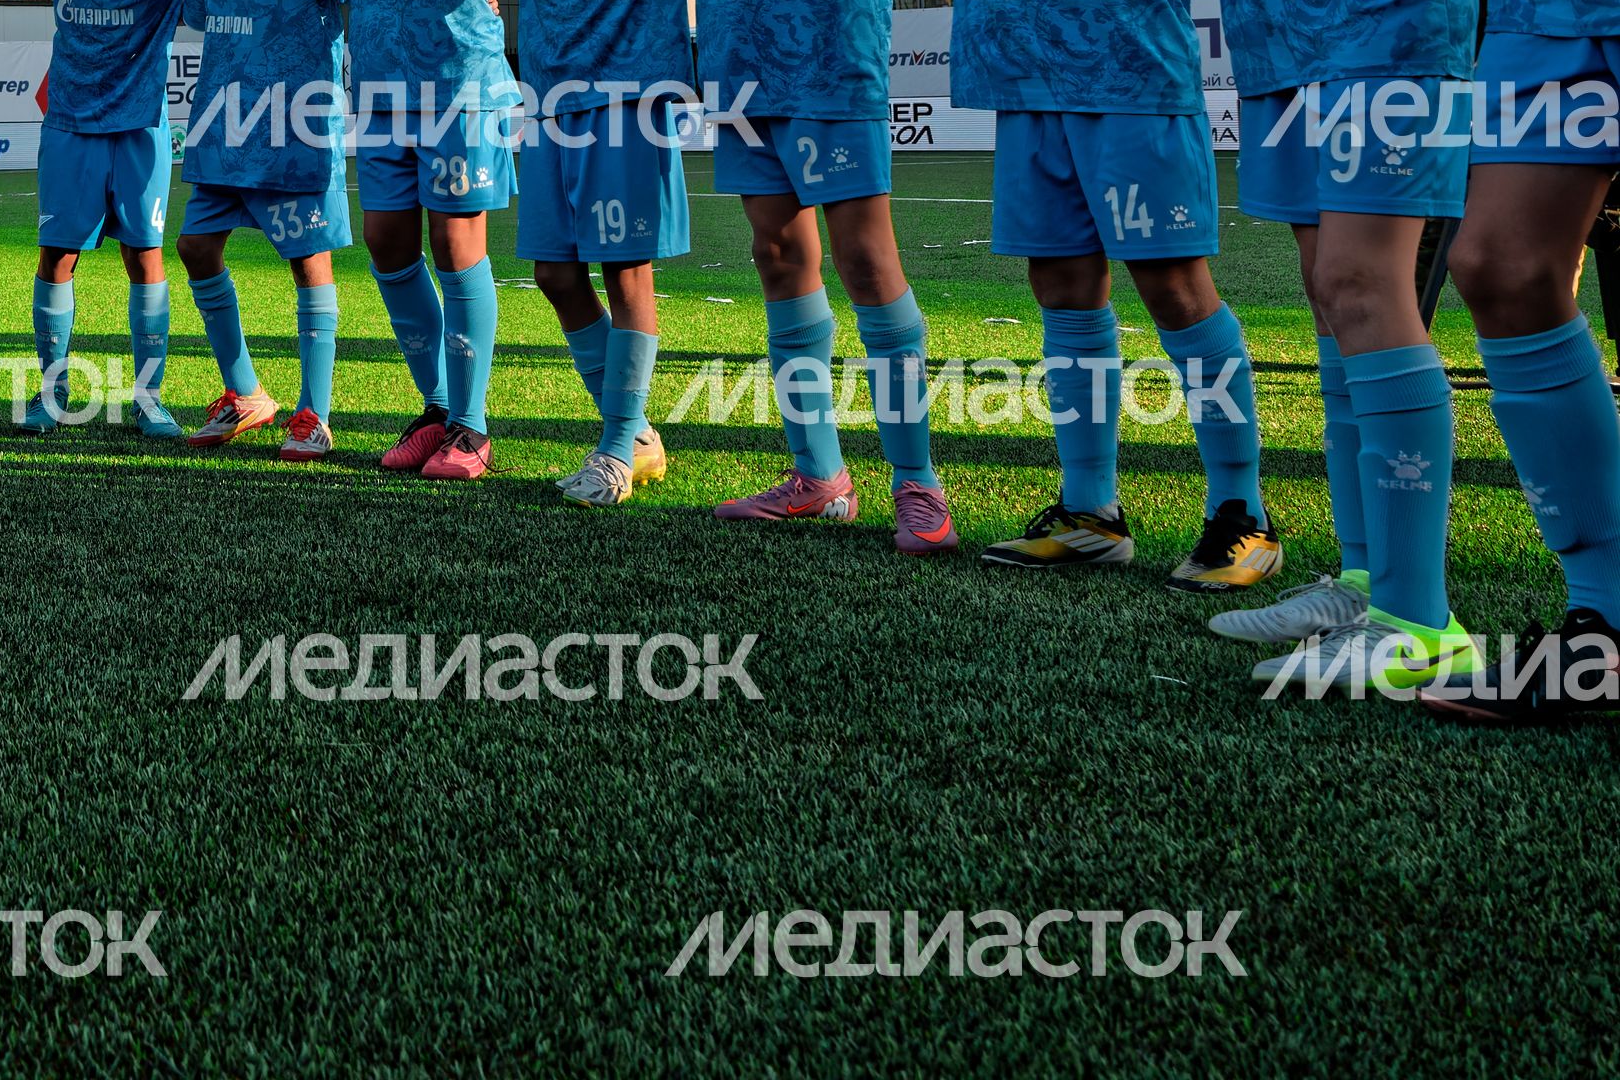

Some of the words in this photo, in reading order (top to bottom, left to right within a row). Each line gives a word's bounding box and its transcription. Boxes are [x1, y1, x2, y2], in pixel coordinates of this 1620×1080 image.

[73, 7, 134, 25] ГАЗПРОМ
[889, 103, 933, 123] ЕР
[796, 136, 824, 184] 2
[827, 161, 860, 173] KELME
[1330, 121, 1362, 184] 9
[1370, 166, 1415, 177] KELME
[431, 156, 470, 197] 28
[267, 200, 305, 243] 33
[591, 199, 626, 244] 19
[1104, 183, 1154, 241] 14
[1166, 221, 1197, 231] KELME
